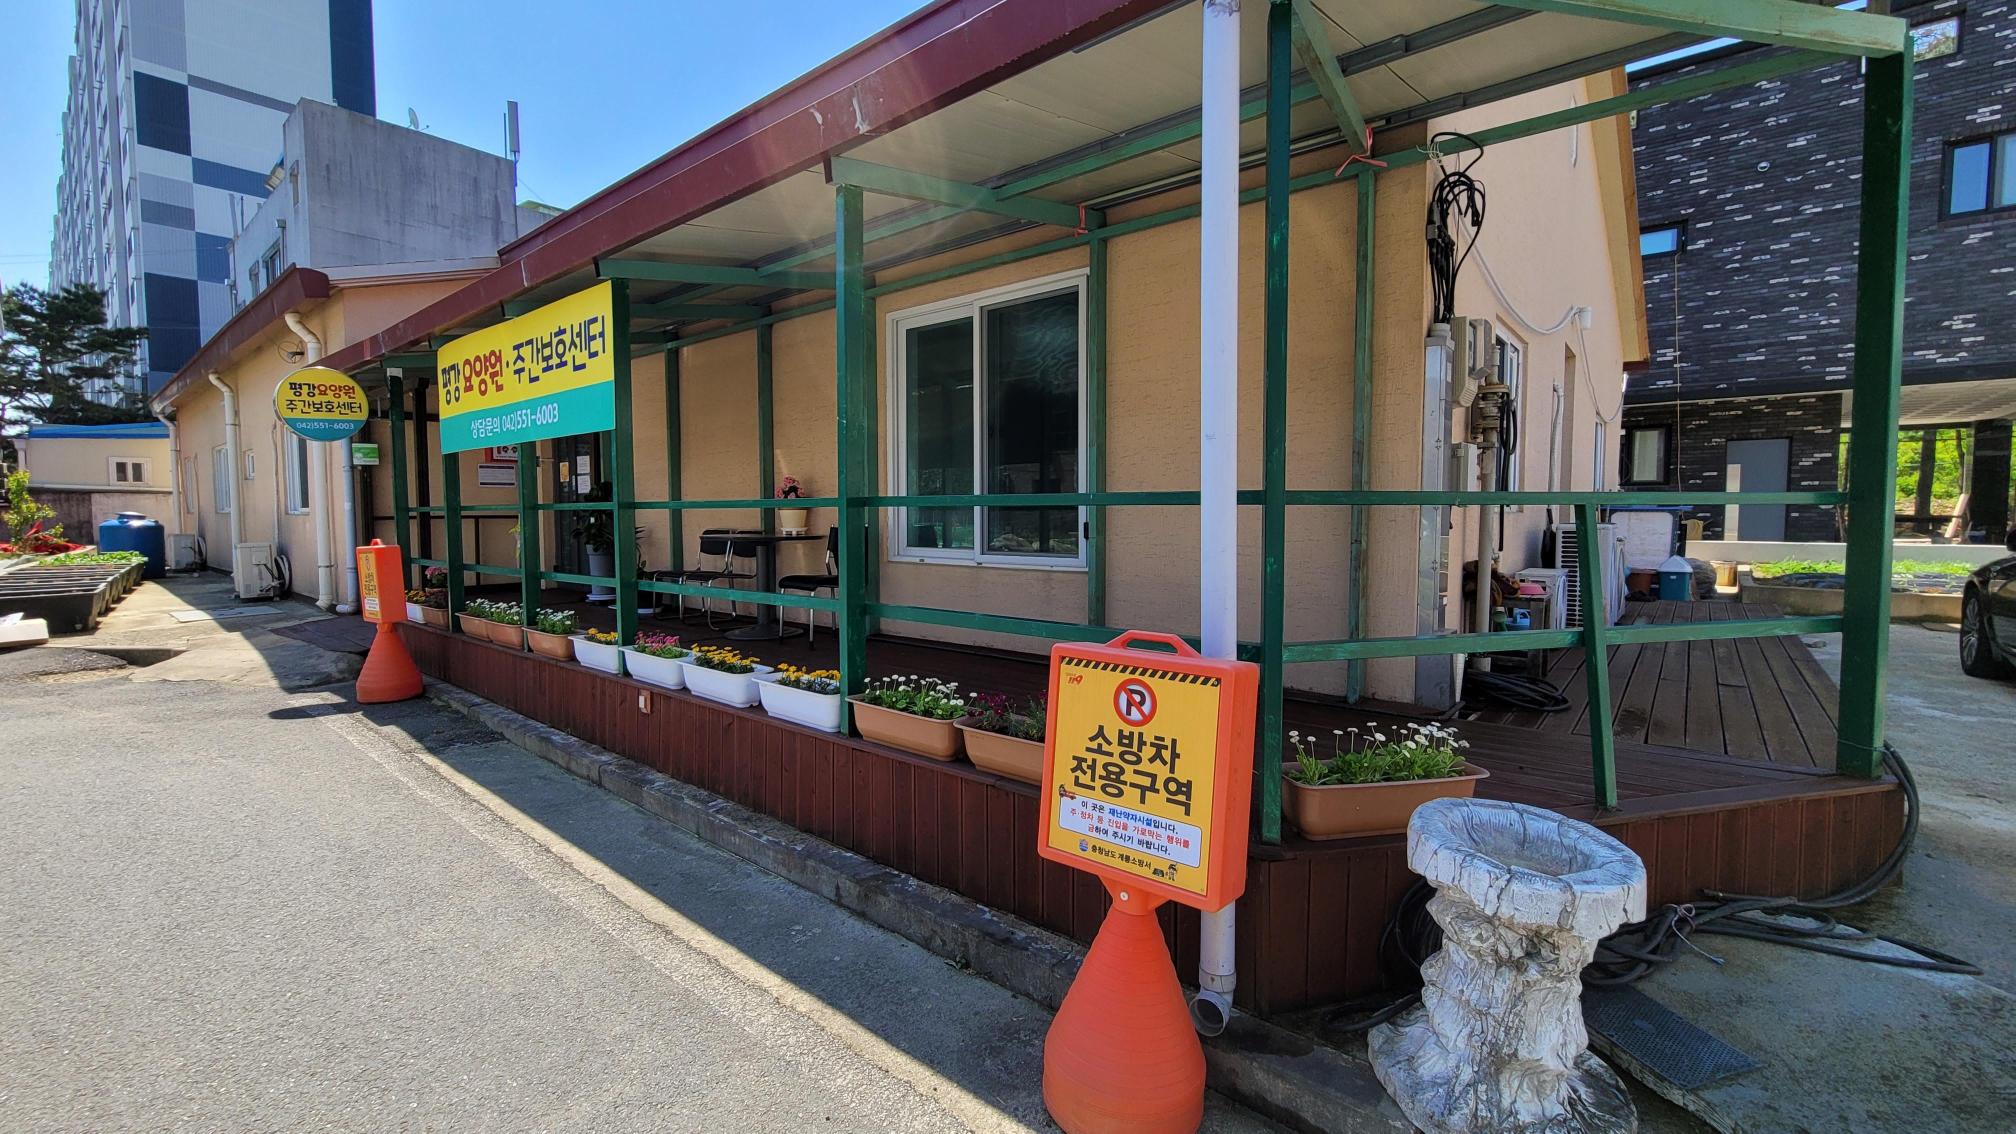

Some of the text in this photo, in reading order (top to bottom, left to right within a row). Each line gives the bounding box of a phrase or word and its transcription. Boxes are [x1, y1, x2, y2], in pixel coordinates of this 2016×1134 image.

[441, 362, 461, 405] 평강
[462, 349, 504, 397] 요양원
[512, 314, 606, 384] 주간보호센터
[288, 382, 356, 399] 평강요양원
[286, 399, 362, 415] 주간보호센터
[296, 422, 354, 430] 042)551-6003
[471, 402, 559, 439] 상담문의 042)551-6003
[1085, 724, 1181, 775] 소방차
[1070, 755, 1193, 816] 전용구역
[1081, 800, 1088, 810] 이
[1091, 802, 1105, 815] 곳은
[1088, 823, 1109, 838] 금하여
[1112, 831, 1134, 846] 주시기
